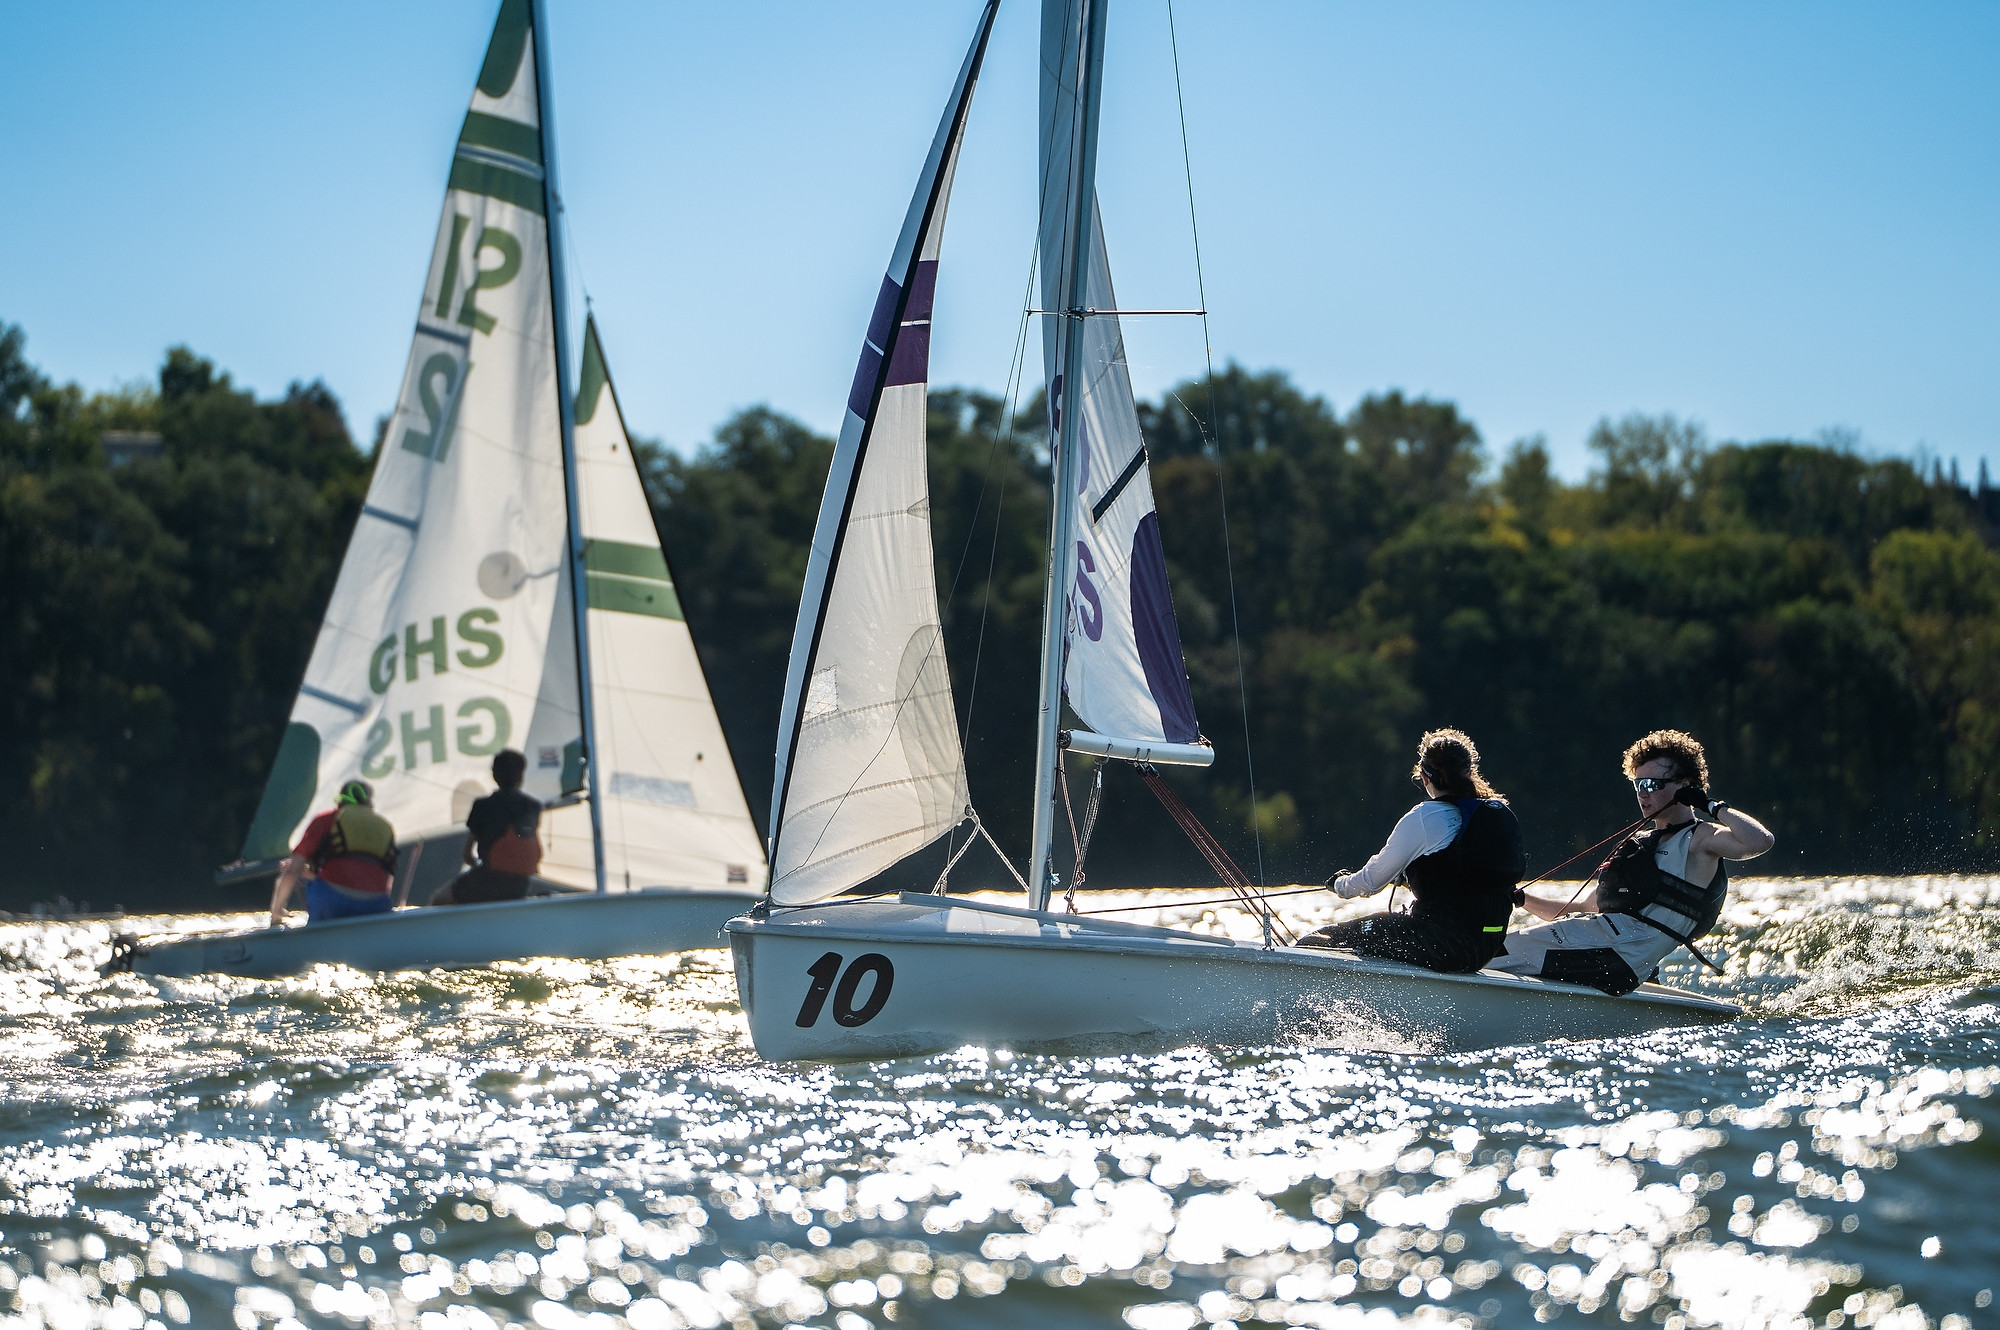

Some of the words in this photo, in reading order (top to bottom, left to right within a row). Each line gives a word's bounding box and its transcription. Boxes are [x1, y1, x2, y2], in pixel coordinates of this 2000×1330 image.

[434, 213, 522, 338] 12
[369, 607, 504, 695] GHS
[795, 952, 895, 1028] 10
